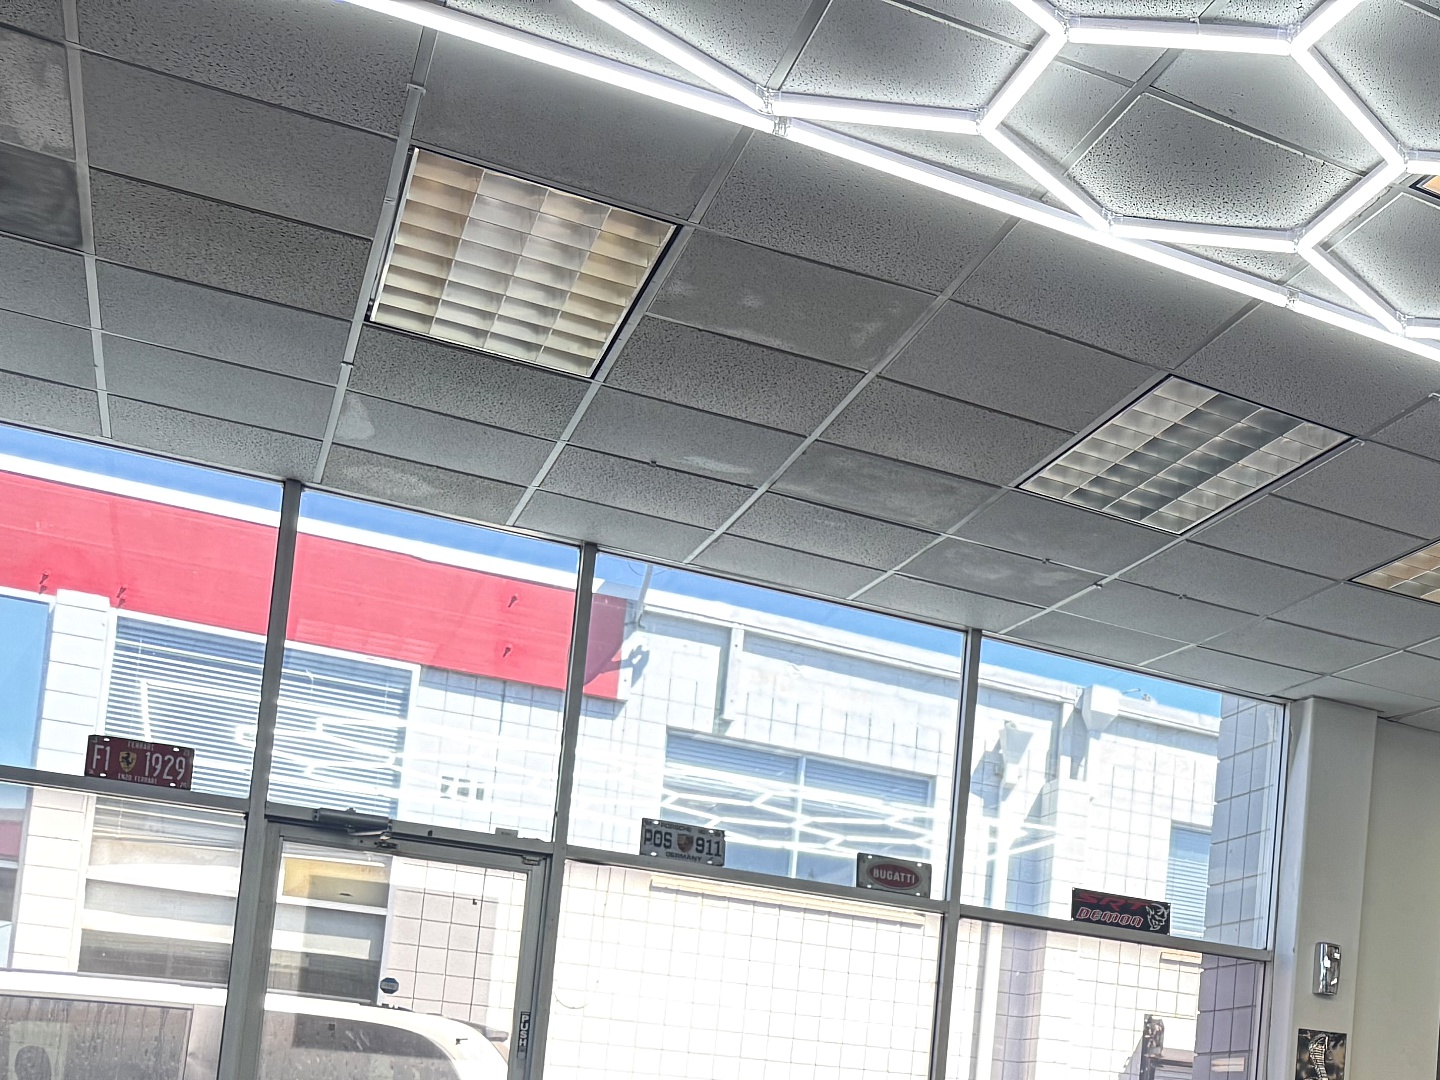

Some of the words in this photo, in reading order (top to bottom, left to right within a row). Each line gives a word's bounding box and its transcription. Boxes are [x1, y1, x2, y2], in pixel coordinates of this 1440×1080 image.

[92, 744, 111, 771] F1
[144, 752, 186, 780] 1929
[643, 828, 672, 849] POS
[695, 837, 722, 857] 911
[665, 851, 703, 862] GERMANY
[873, 868, 915, 884] BUGATTI
[1074, 892, 1151, 911] SRT
[519, 1015, 530, 1046] PUSH
